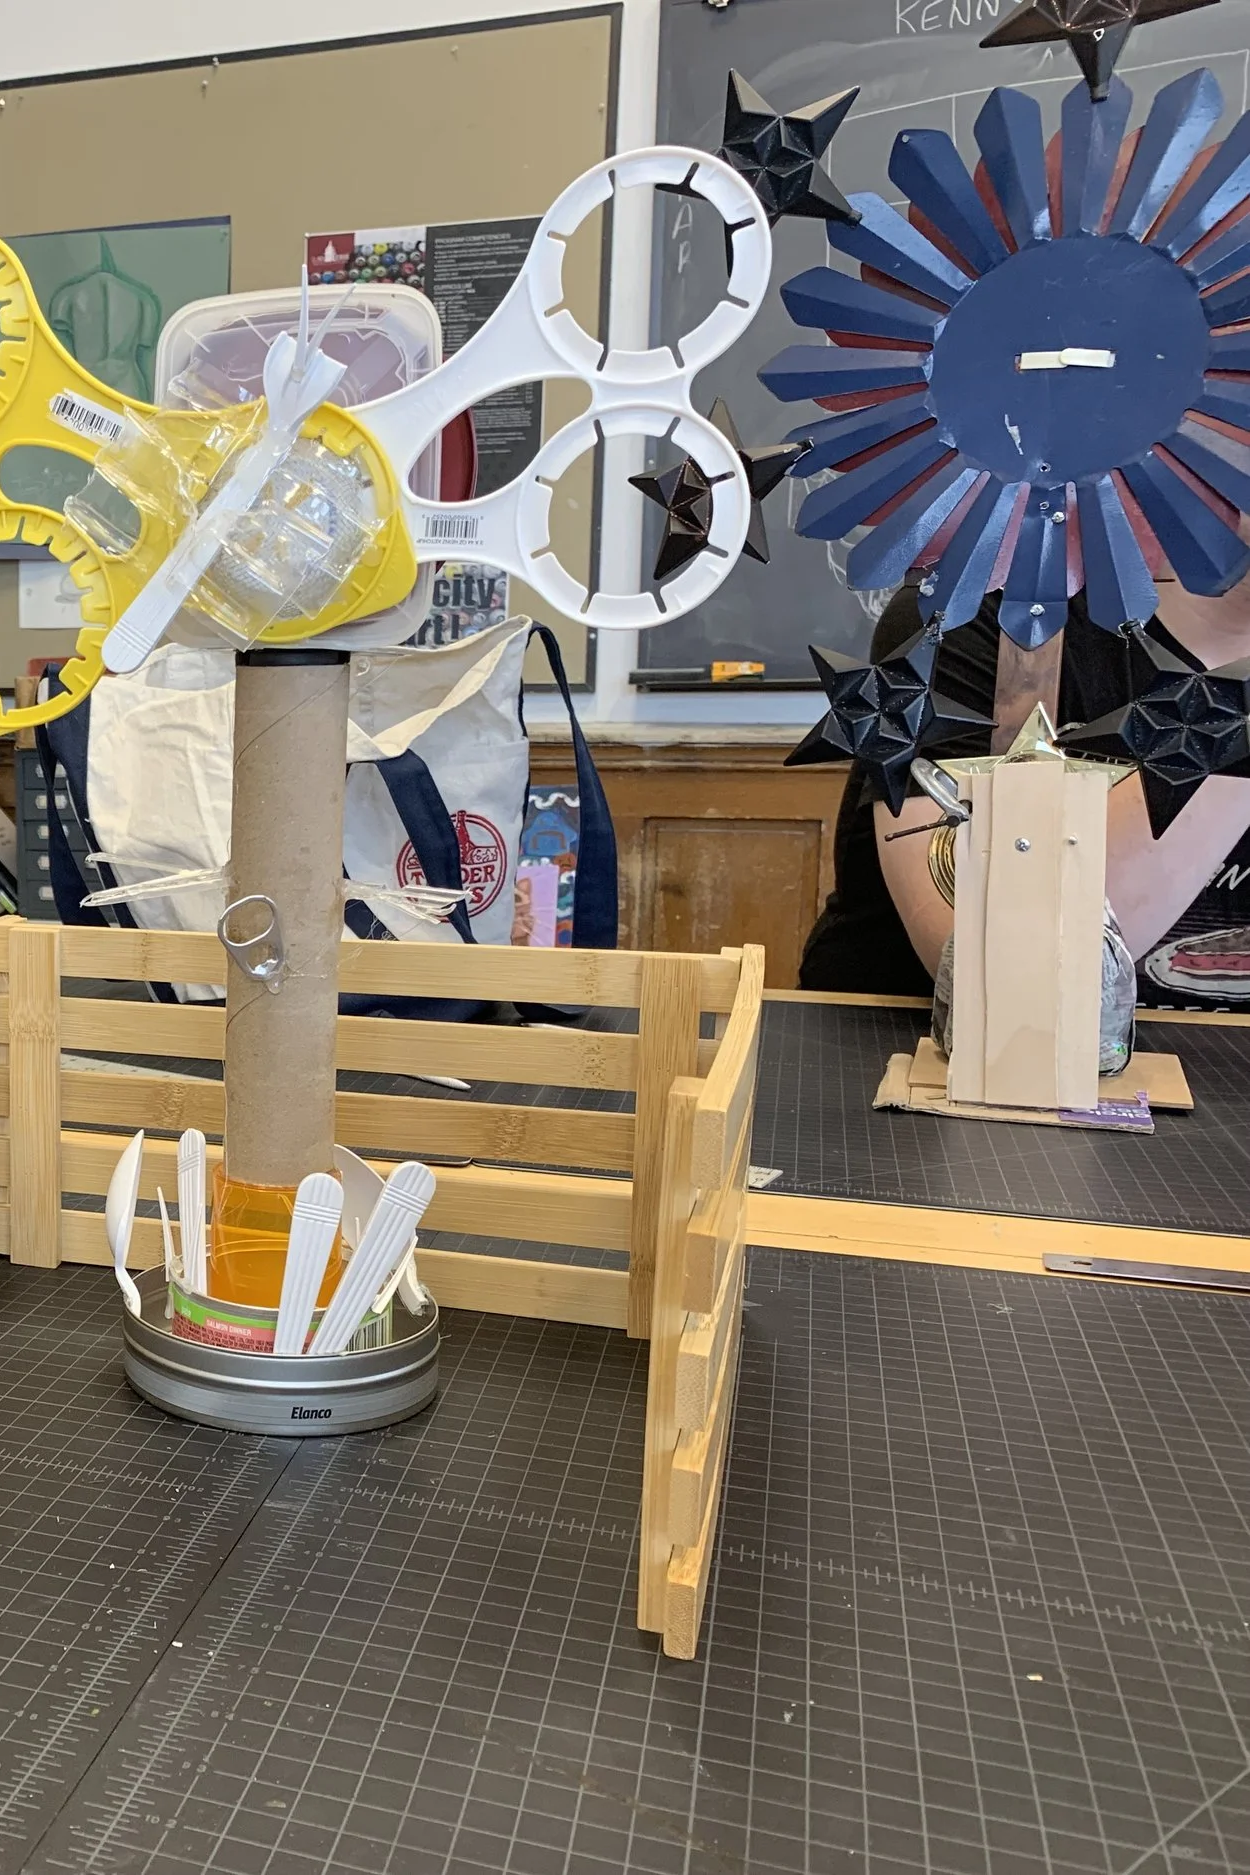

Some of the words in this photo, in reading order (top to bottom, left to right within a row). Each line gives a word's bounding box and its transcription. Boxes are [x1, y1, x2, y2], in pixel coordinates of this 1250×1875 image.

[896, 0, 1002, 34] KENN
[206, 1319, 228, 1332] SALMON
[228, 1324, 252, 1336] DINNER
[291, 1406, 332, 1419] Elanco
